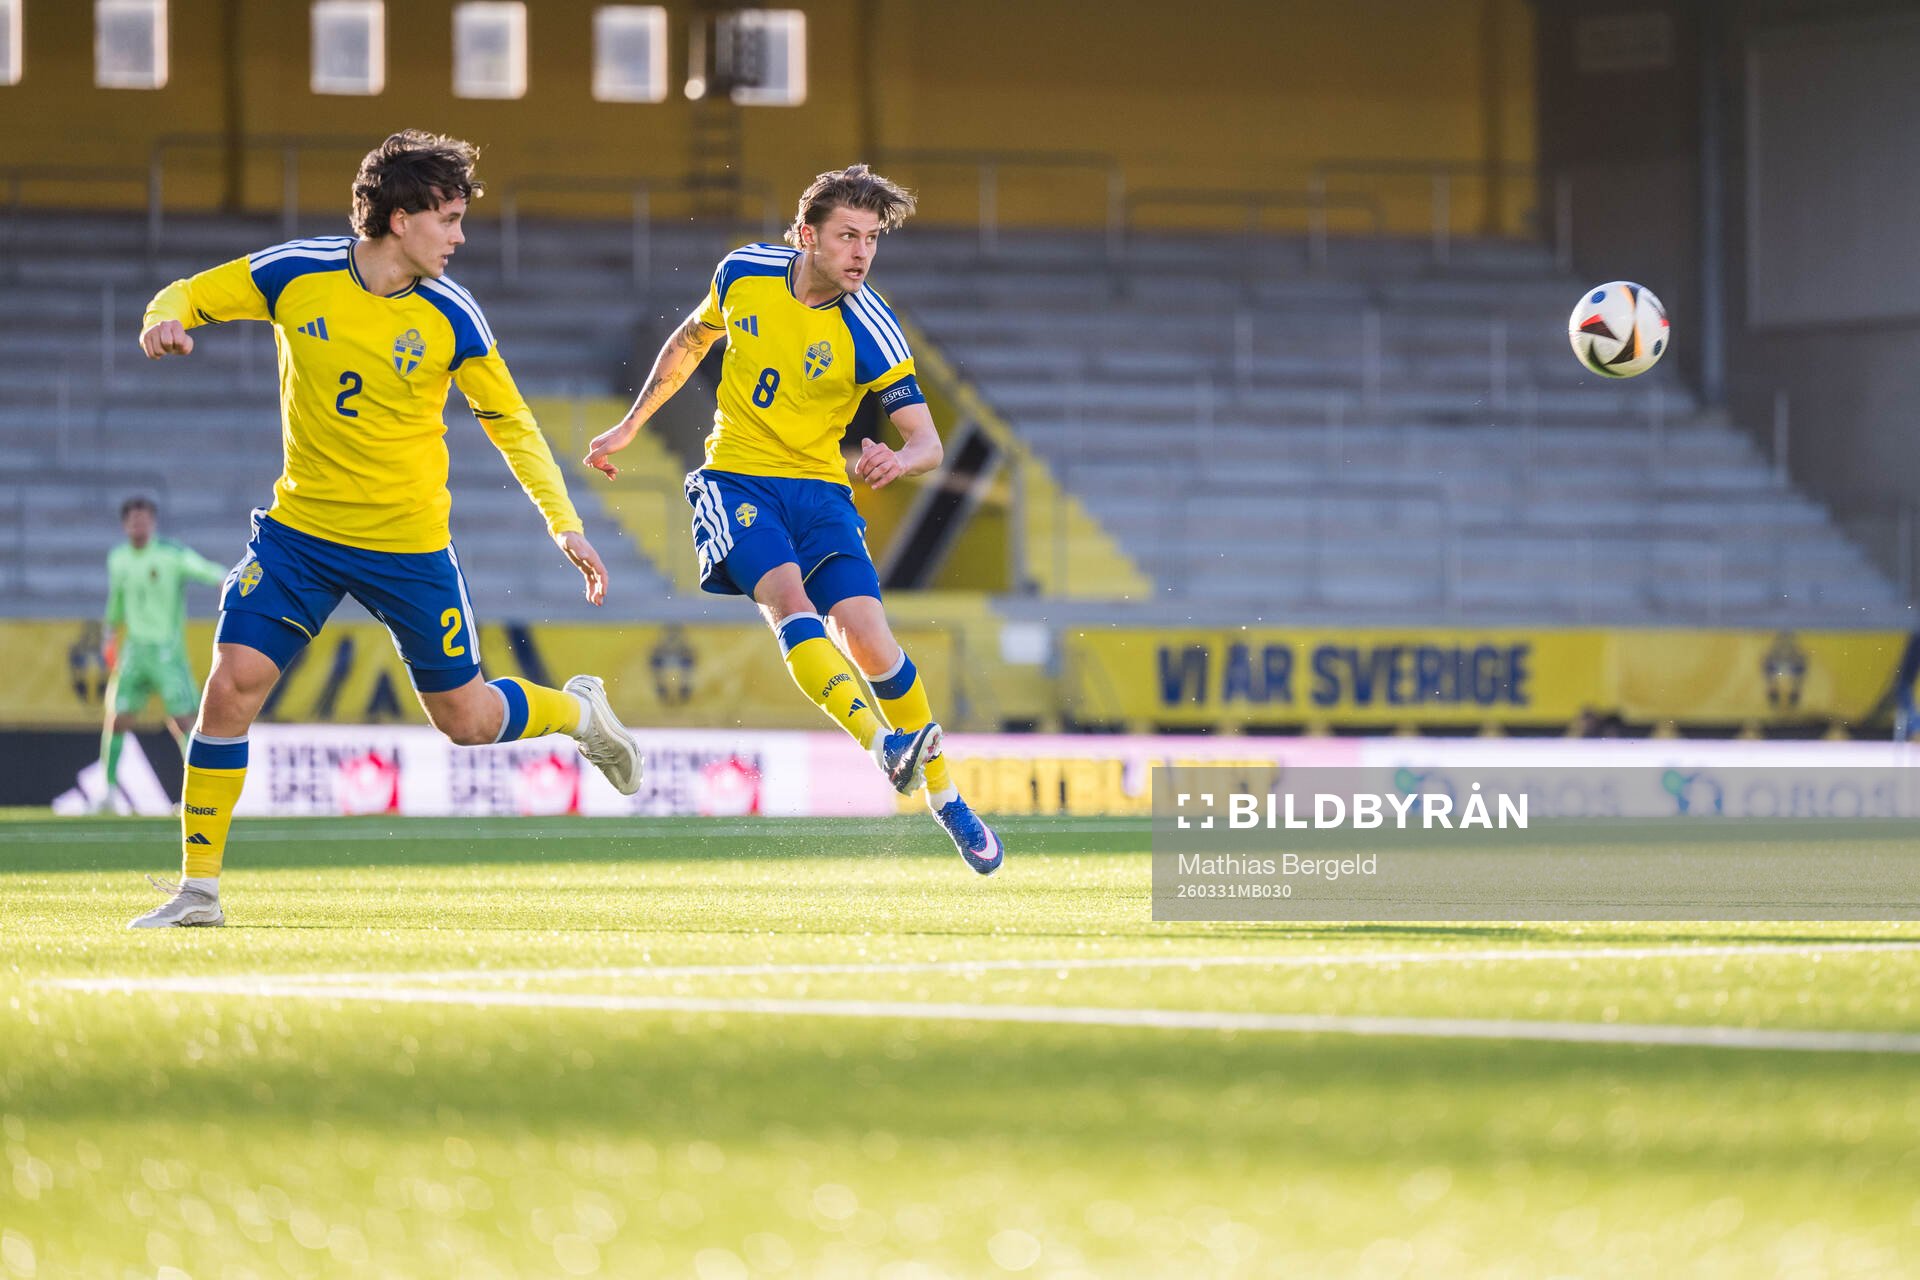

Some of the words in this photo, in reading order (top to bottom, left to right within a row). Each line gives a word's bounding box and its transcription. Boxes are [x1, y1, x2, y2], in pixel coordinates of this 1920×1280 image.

[336, 370, 363, 418] 2
[752, 367, 780, 409] 8
[440, 607, 465, 657] 2
[1158, 645, 1207, 707] VI
[1312, 645, 1531, 707] SVERIGE
